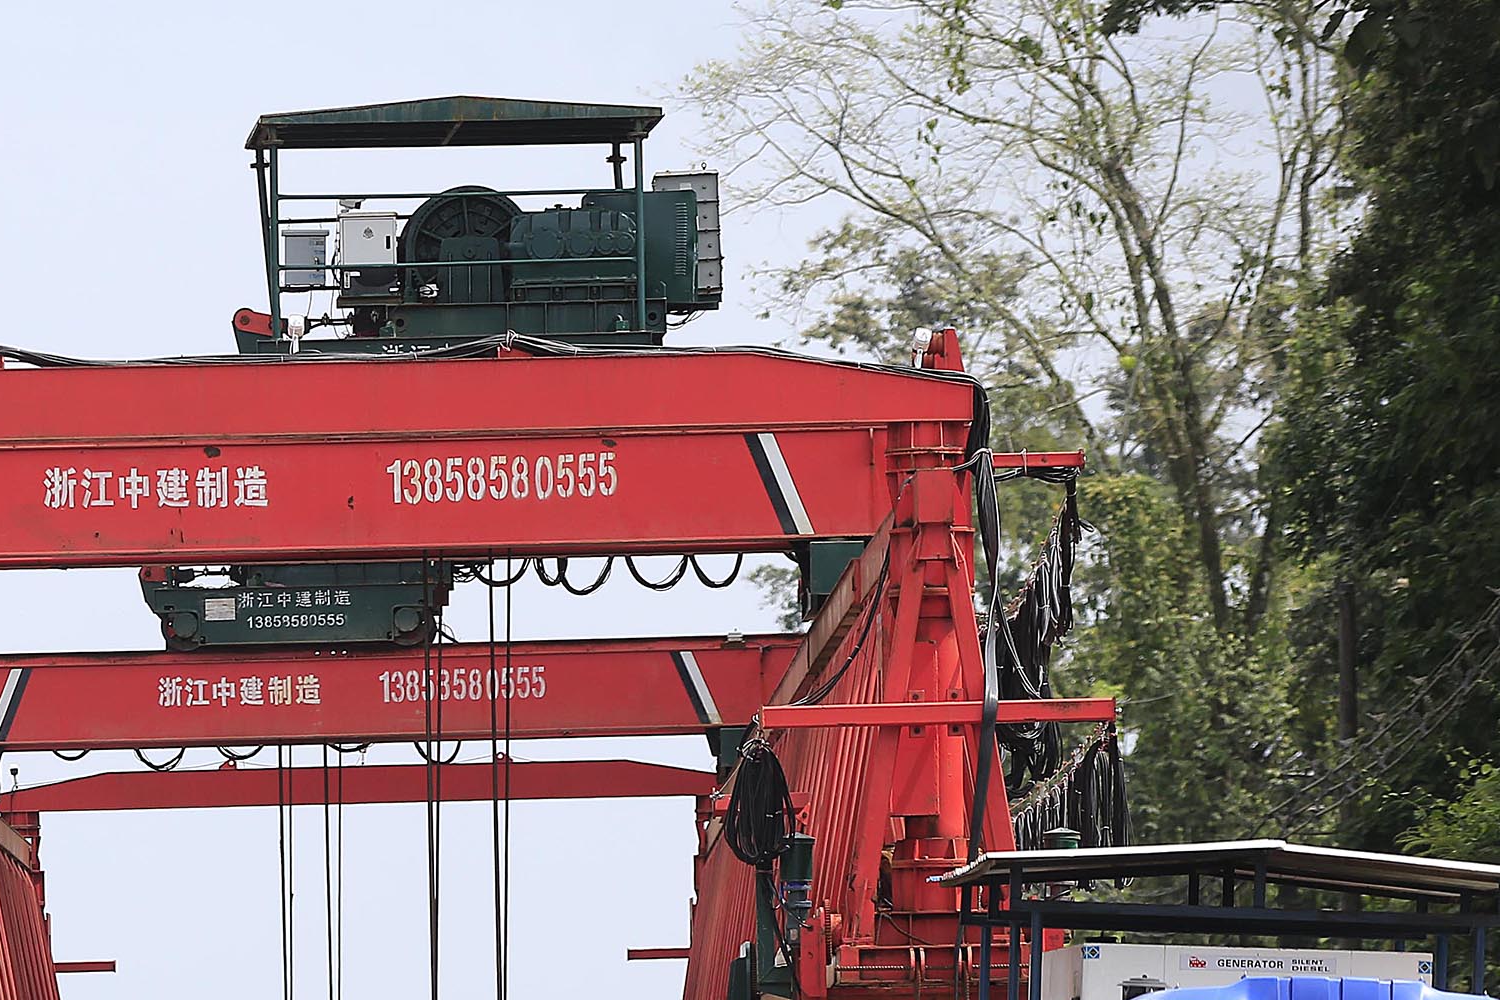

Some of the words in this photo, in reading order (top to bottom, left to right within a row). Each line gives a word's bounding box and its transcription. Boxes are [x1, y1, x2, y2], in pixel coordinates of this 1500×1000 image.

[43, 466, 269, 509] 浙江中建制造
[386, 452, 618, 504] 13858580555
[238, 590, 351, 609] 浙江中建制造
[246, 613, 346, 629] 13858580555
[157, 674, 322, 707] 浙江中建制造
[378, 666, 547, 703] 13858580555
[1217, 958, 1284, 969] GENERATOR
